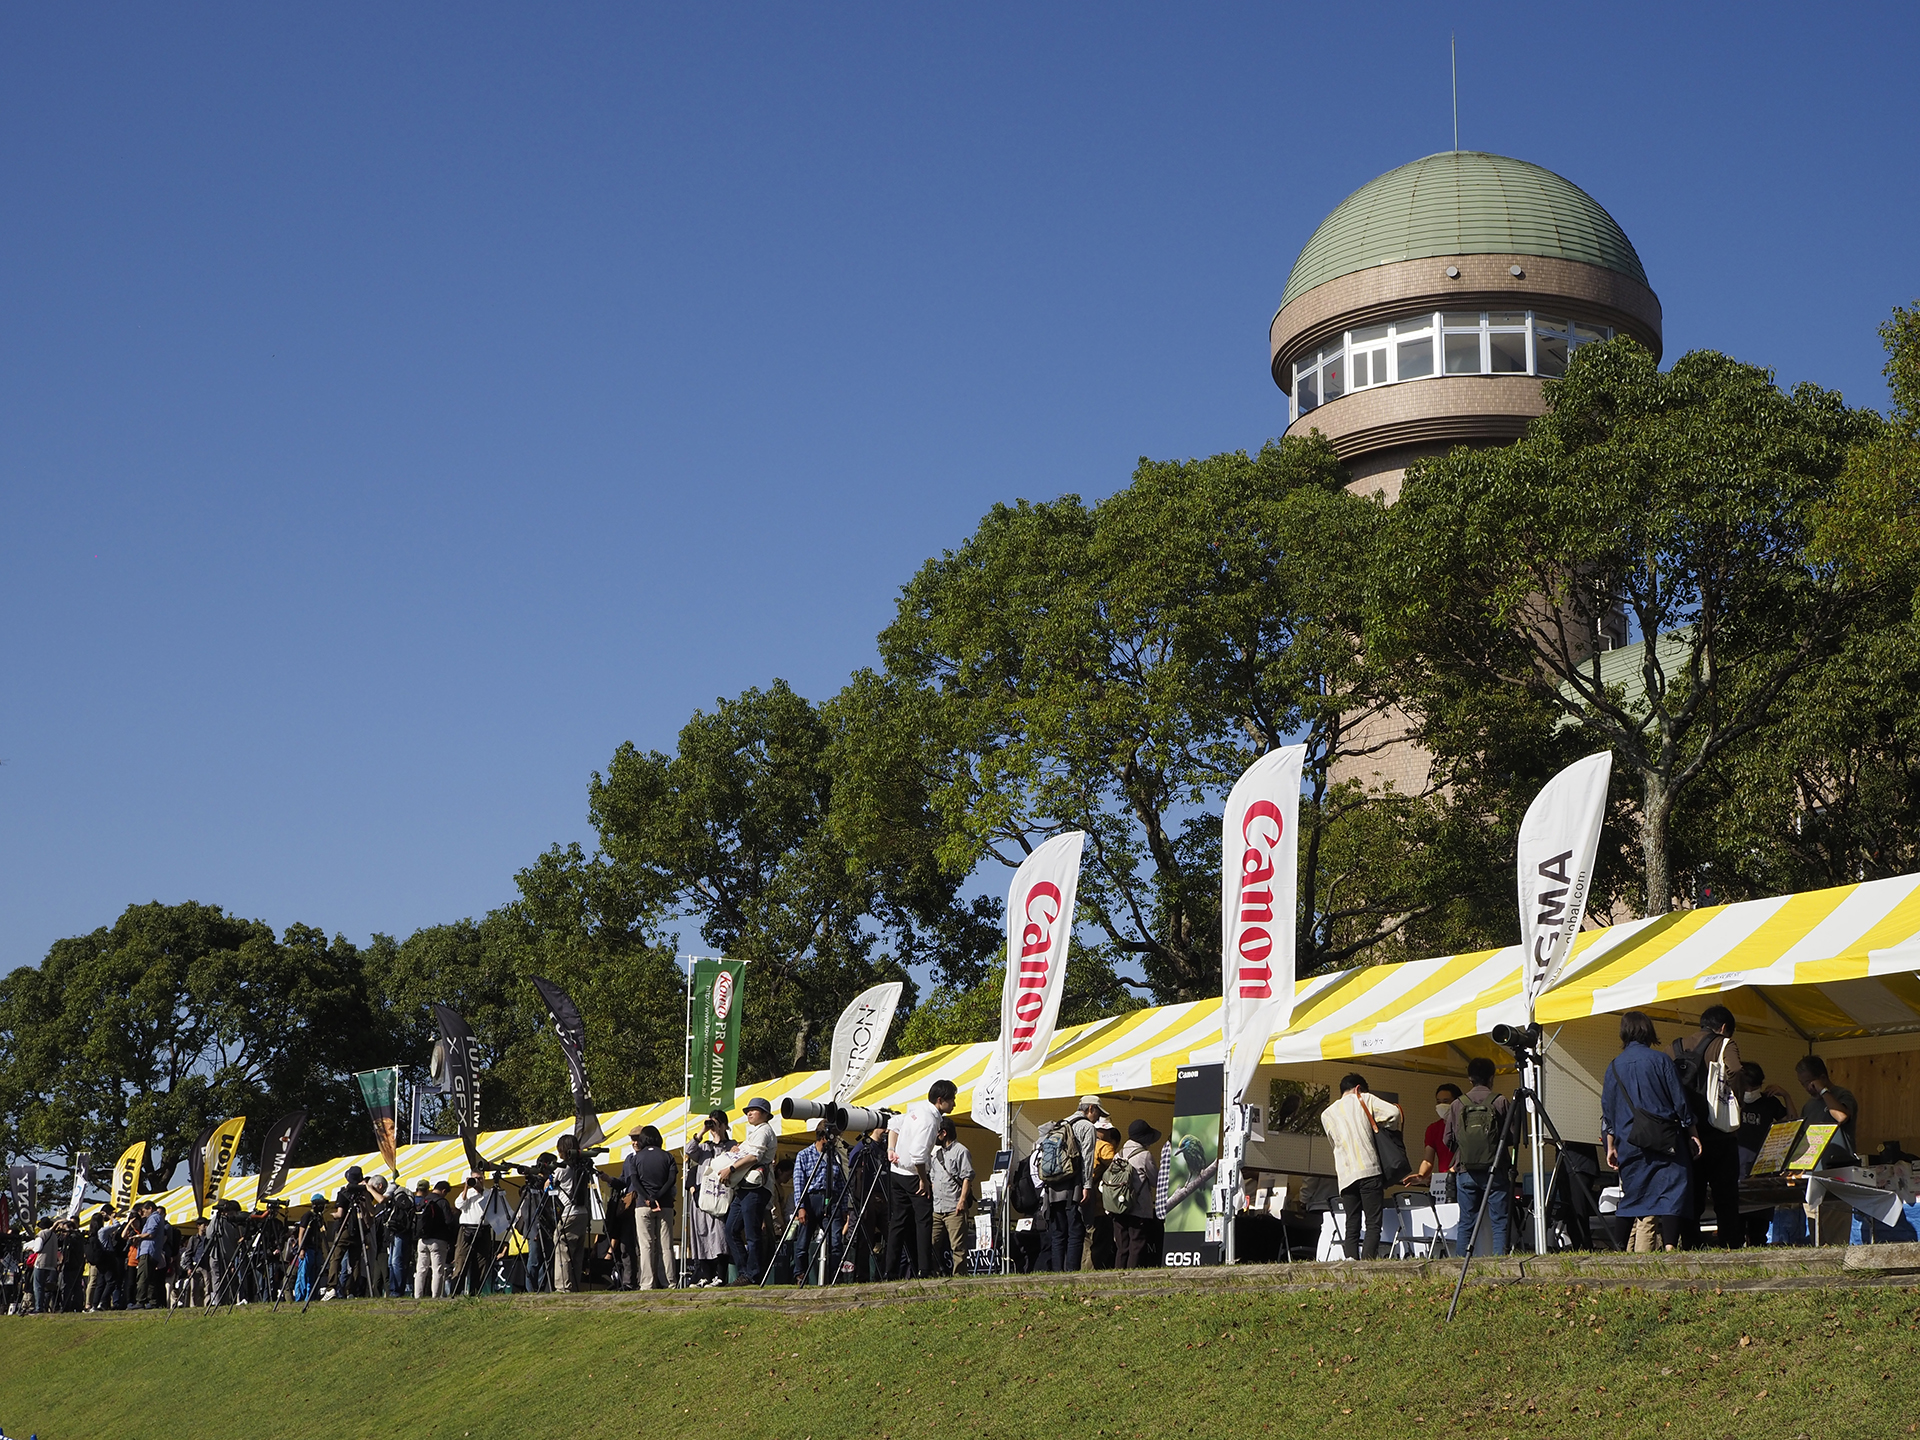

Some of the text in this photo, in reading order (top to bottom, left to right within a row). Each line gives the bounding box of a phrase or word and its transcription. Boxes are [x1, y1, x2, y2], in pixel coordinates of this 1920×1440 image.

[1239, 800, 1284, 998] Canon
[718, 974, 732, 1017] Kowa
[1012, 881, 1062, 1055] Canon
[454, 1075, 468, 1127] GFX
[1178, 1070, 1199, 1079] Canon
[115, 1158, 137, 1218] Nikon
[205, 1134, 236, 1201] Nikon
[1165, 1251, 1201, 1267] EOS R
